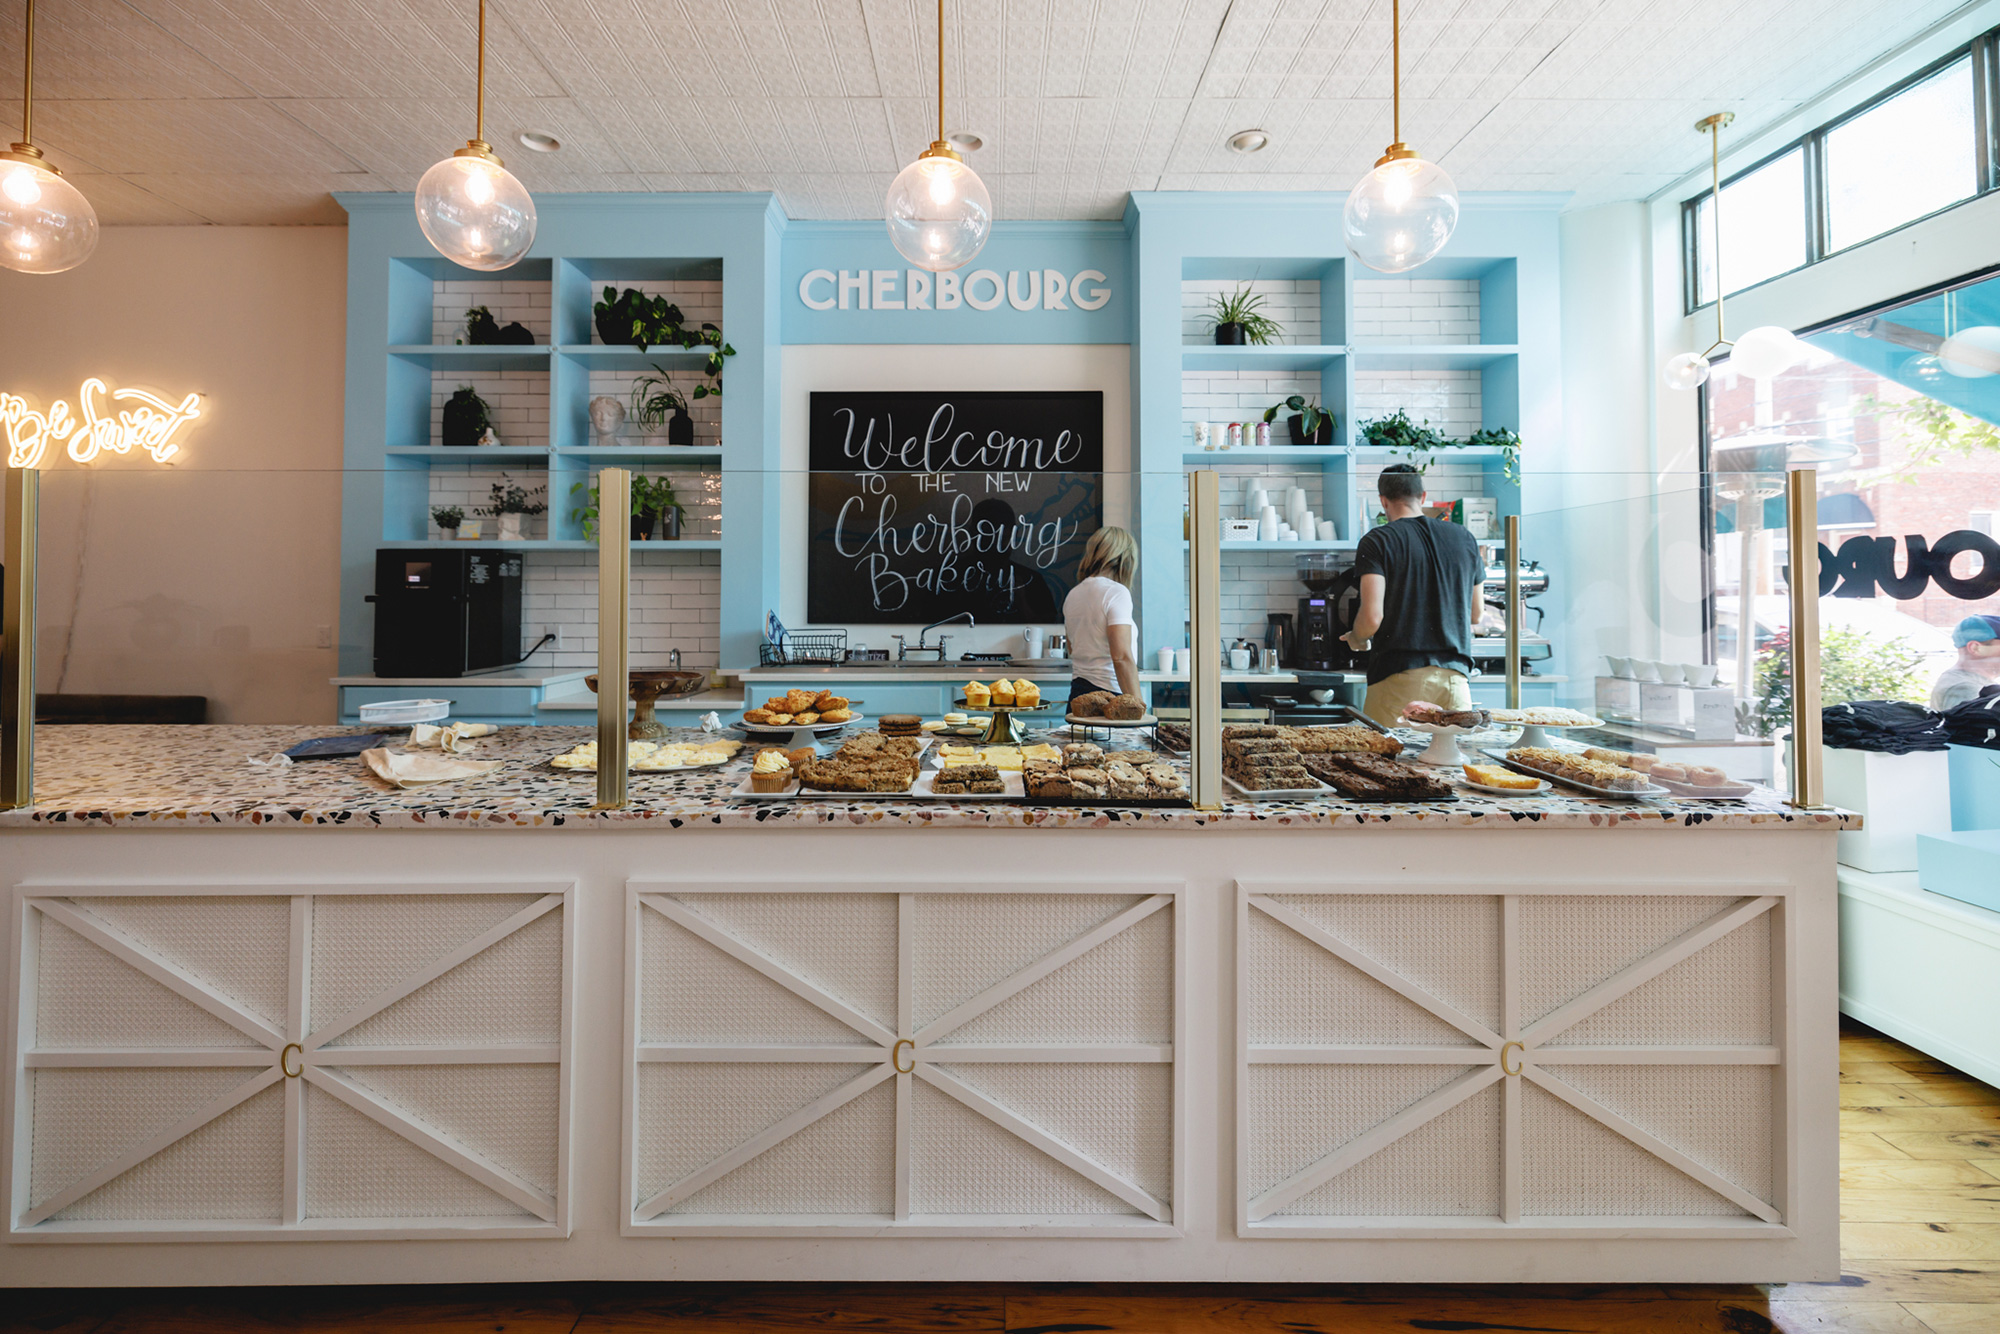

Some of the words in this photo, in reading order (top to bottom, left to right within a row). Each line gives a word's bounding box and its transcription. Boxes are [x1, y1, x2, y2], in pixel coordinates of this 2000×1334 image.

[799, 268, 1112, 311] CHERBOURG
[0, 392, 76, 468] Be
[67, 377, 201, 463] Sweet
[833, 402, 1082, 475] Welcome
[855, 473, 887, 494] TO
[911, 473, 957, 492] THE
[985, 472, 1032, 492] NEW
[835, 493, 1079, 569] Cherbourg
[855, 550, 1034, 612] Bakery
[848, 653, 886, 661] STIZE
[281, 1043, 304, 1078] C
[893, 1039, 915, 1074] C
[1501, 1041, 1525, 1077] C
